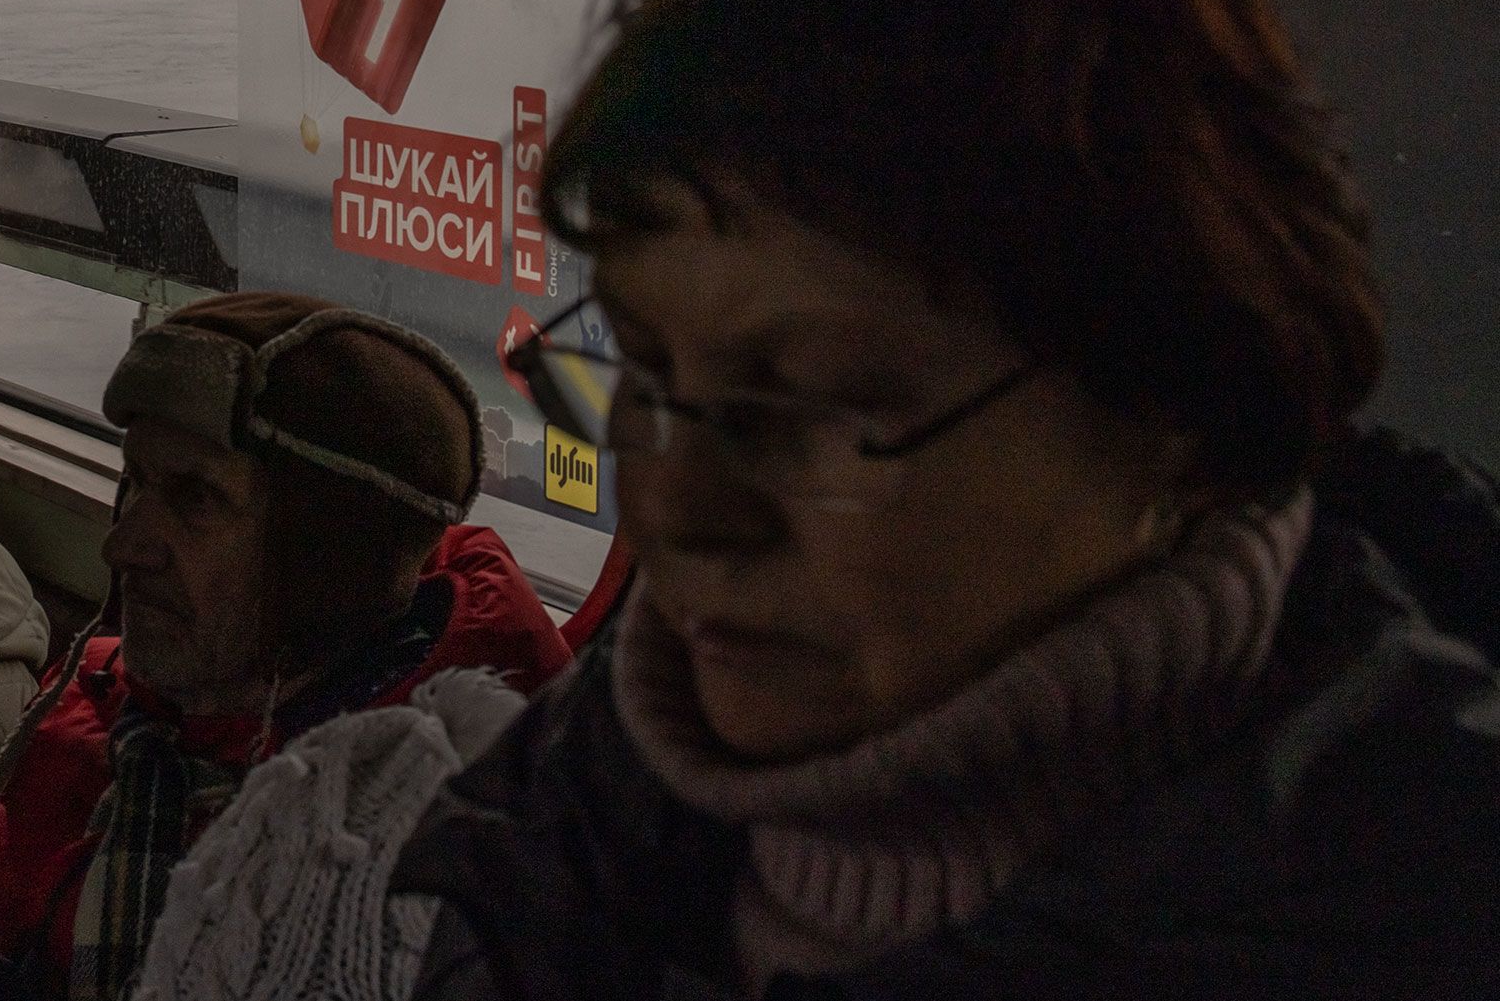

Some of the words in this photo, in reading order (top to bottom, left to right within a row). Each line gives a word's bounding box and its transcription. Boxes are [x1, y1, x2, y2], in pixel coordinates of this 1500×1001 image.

[349, 138, 494, 209] ШУКАЙ
[516, 100, 543, 282] FIRST
[340, 192, 494, 267] ПЛЮСИ
